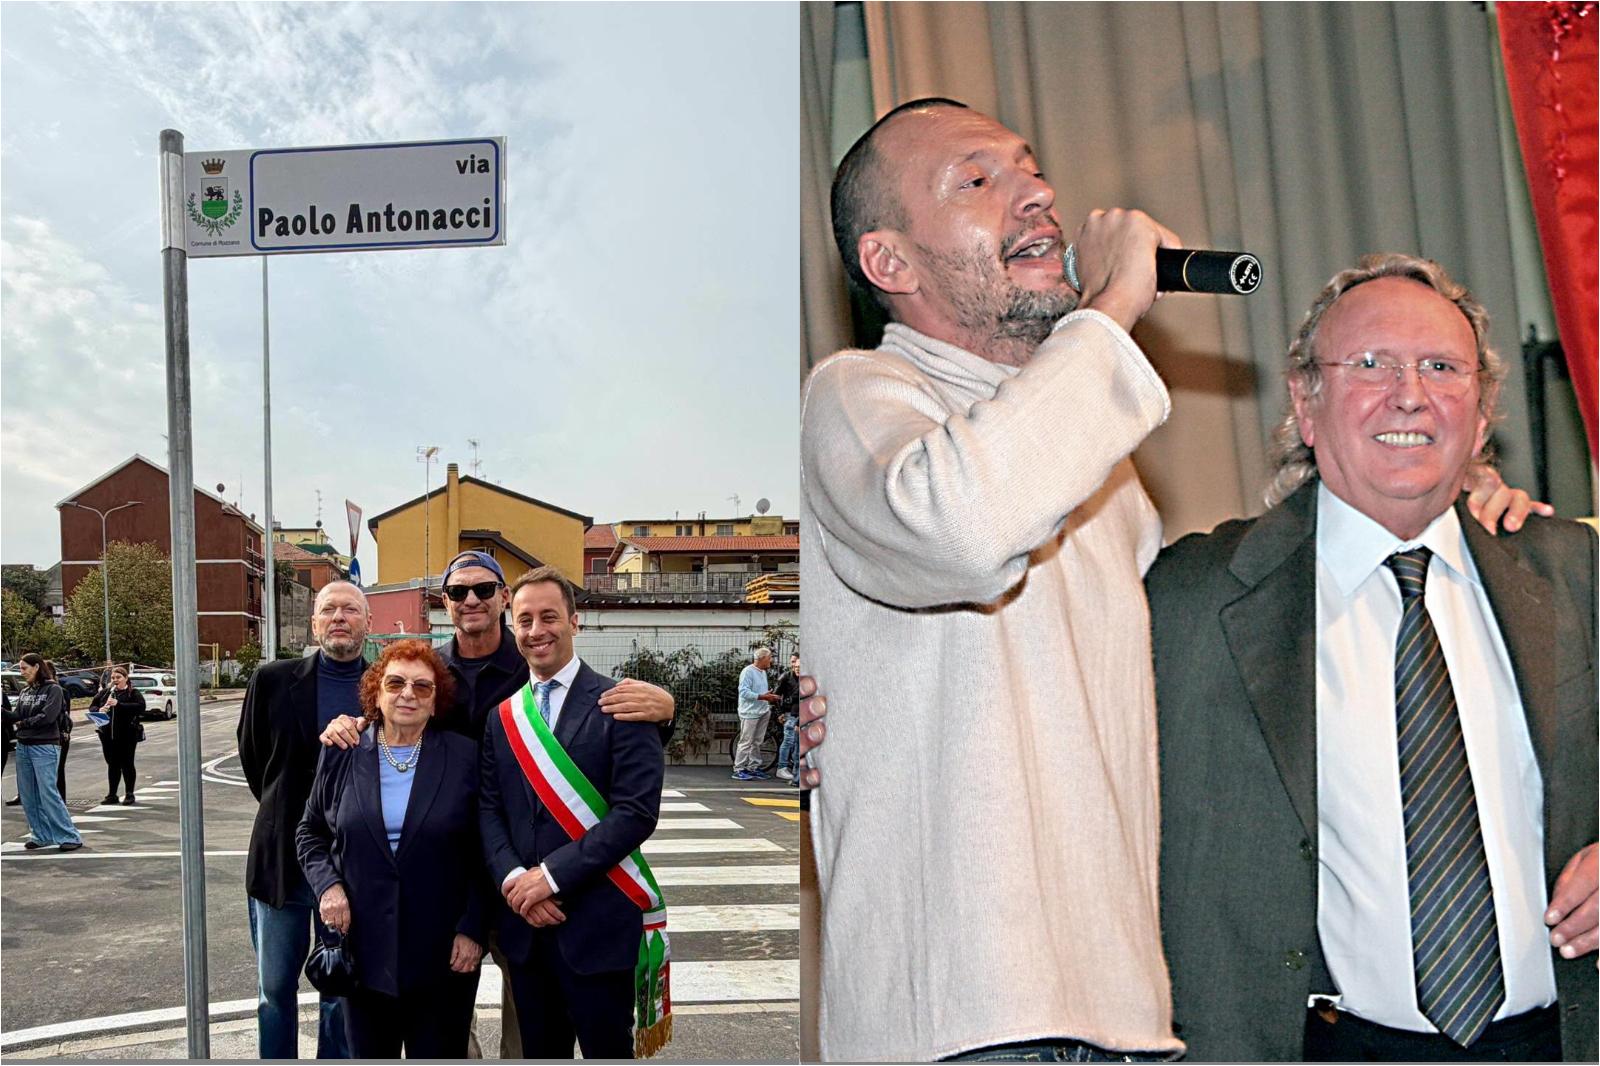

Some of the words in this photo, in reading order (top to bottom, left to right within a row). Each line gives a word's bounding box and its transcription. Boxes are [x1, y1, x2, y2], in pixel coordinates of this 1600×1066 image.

[455, 154, 490, 175] via
[258, 205, 336, 238] Paolo
[346, 197, 491, 234] Antonacci
